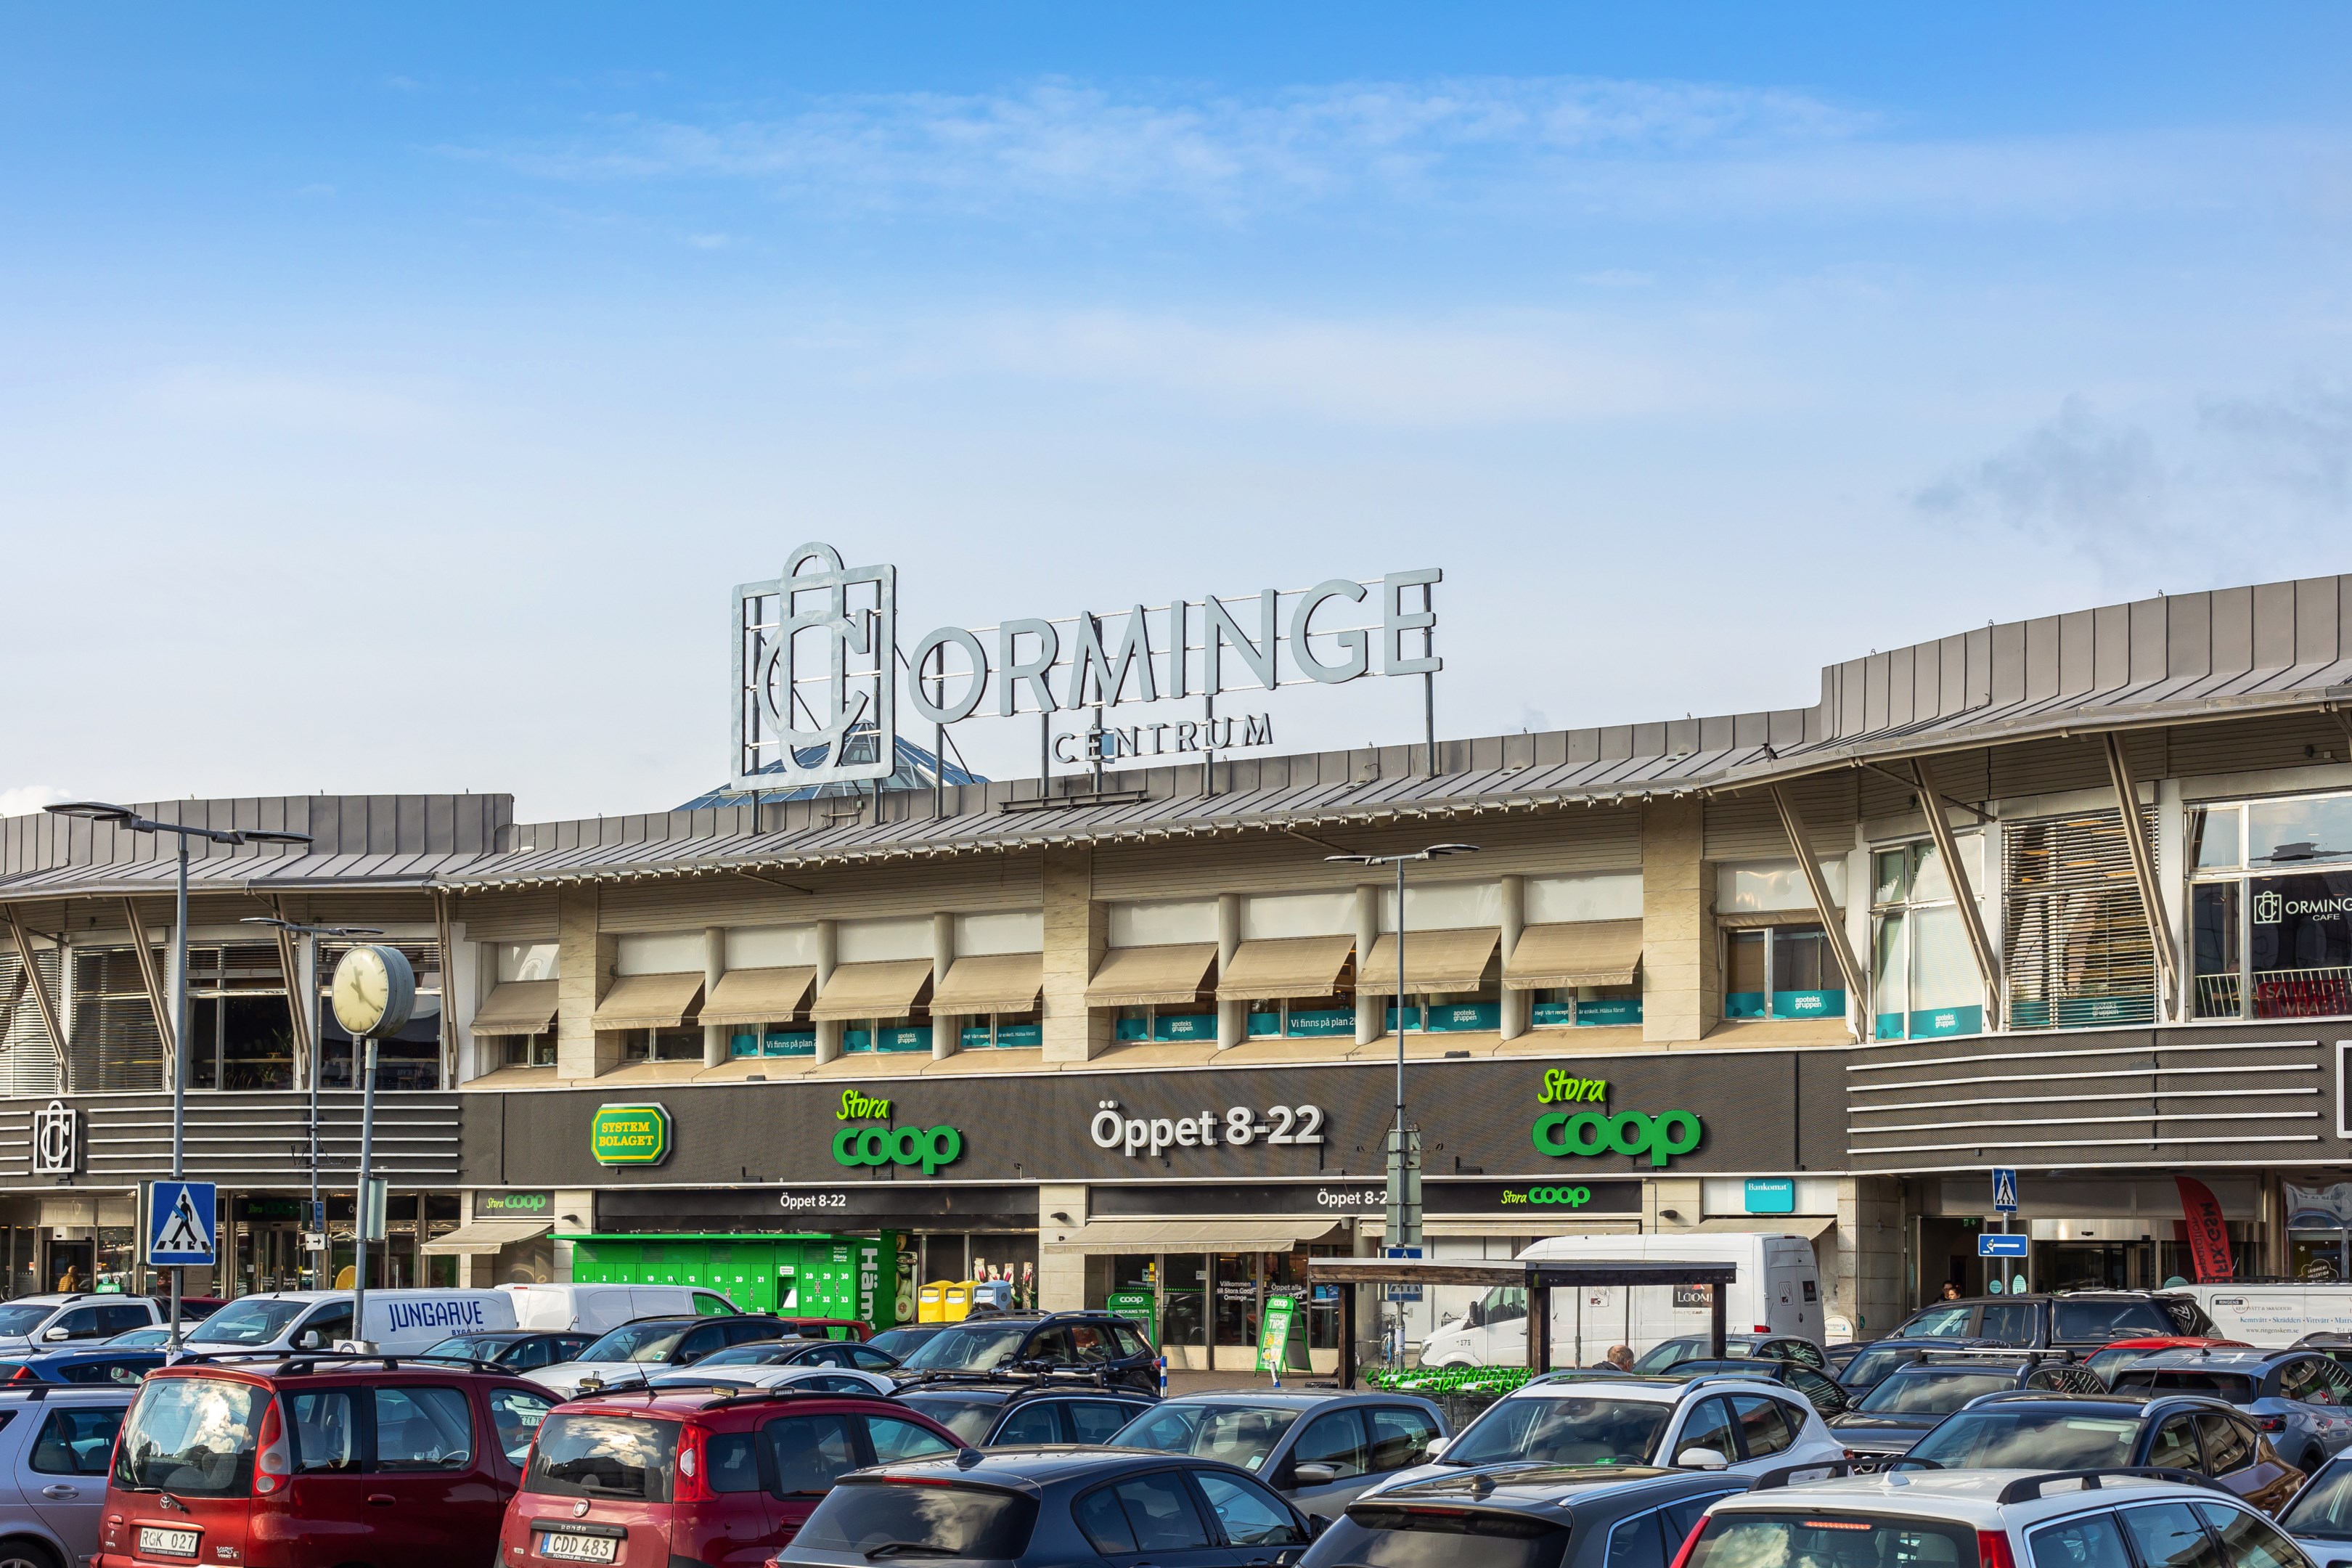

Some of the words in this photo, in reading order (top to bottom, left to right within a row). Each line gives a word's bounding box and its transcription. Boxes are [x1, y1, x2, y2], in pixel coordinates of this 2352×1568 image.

[908, 568, 1442, 723] ORMINGE
[1051, 712, 1273, 764] CENTRUM
[1300, 1018, 1319, 1027] finns
[1320, 1017, 1330, 1029] på
[1331, 1017, 1348, 1028] plan
[791, 1040, 799, 1049] på
[799, 1039, 813, 1049] plan
[1538, 1068, 1609, 1104] Stora
[836, 1089, 893, 1120] Stora
[601, 1121, 650, 1133] SYSTEM
[1090, 1100, 1219, 1157] Öppet
[1226, 1104, 1325, 1146] 8-22
[597, 1134, 655, 1148] BOLAGET
[1532, 1109, 1703, 1167] coop
[832, 1125, 963, 1175] coop
[1500, 1189, 1527, 1205] Stora
[1528, 1186, 1591, 1208] coop
[1748, 1183, 1787, 1191] Bankomat
[486, 1197, 505, 1209] Stora
[505, 1194, 546, 1212] coop
[780, 1193, 816, 1209] Öppet
[818, 1194, 846, 1207] 8-22
[1317, 1188, 1361, 1208] Öppet
[1364, 1191, 1387, 1205] 8-2
[860, 1248, 878, 1331] Häm
[1678, 1291, 1712, 1302] LOOMI
[1273, 1299, 1289, 1308] coop
[388, 1301, 483, 1332] JUNGARVE
[1269, 1318, 1286, 1329] TIPS
[142, 1530, 164, 1548] RGK
[171, 1532, 195, 1550] 027
[216, 1545, 234, 1554] YARIS
[552, 1535, 579, 1553] CDD
[581, 1538, 611, 1557] 483
